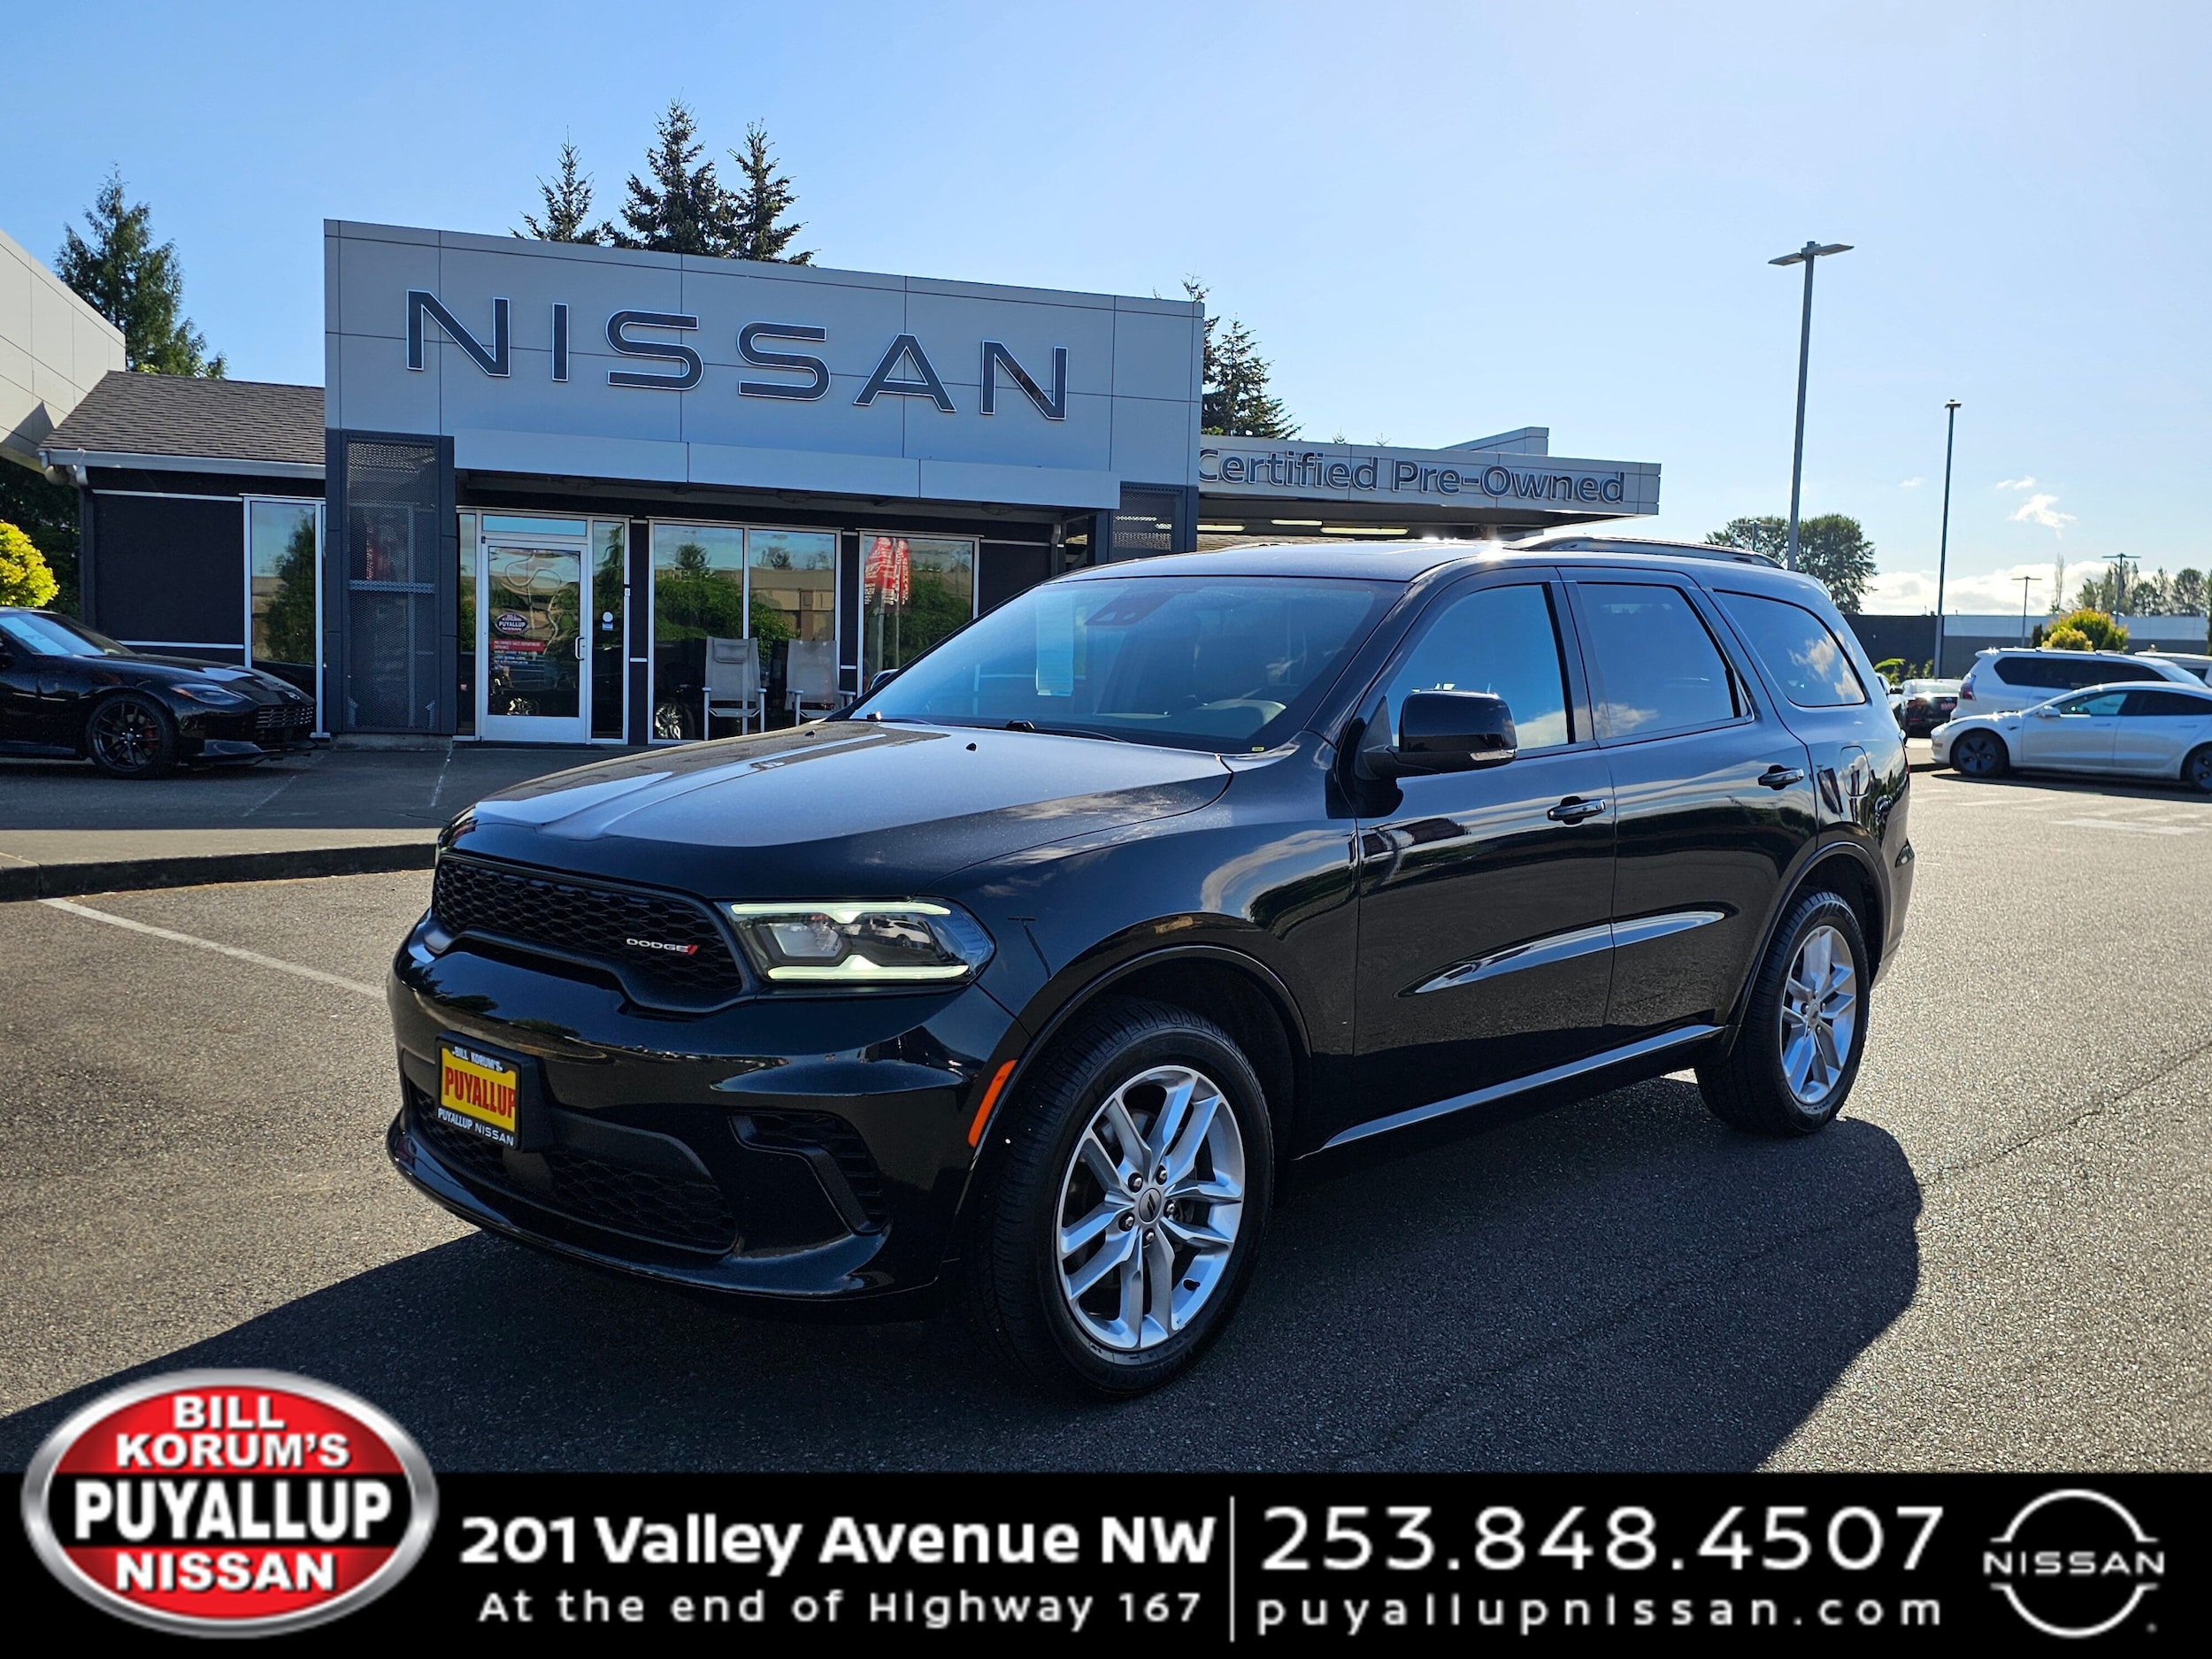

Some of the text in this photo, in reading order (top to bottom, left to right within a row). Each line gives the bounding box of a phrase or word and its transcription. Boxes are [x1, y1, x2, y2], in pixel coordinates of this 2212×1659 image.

[405, 288, 1069, 421] NISSAN
[1199, 448, 1626, 503] Certified Pre-Owned
[626, 938, 688, 953] DODGE
[454, 1046, 469, 1060] BILL
[444, 1065, 516, 1119] PUYALLUP
[438, 1108, 514, 1147] PUYALLUP NISSAN
